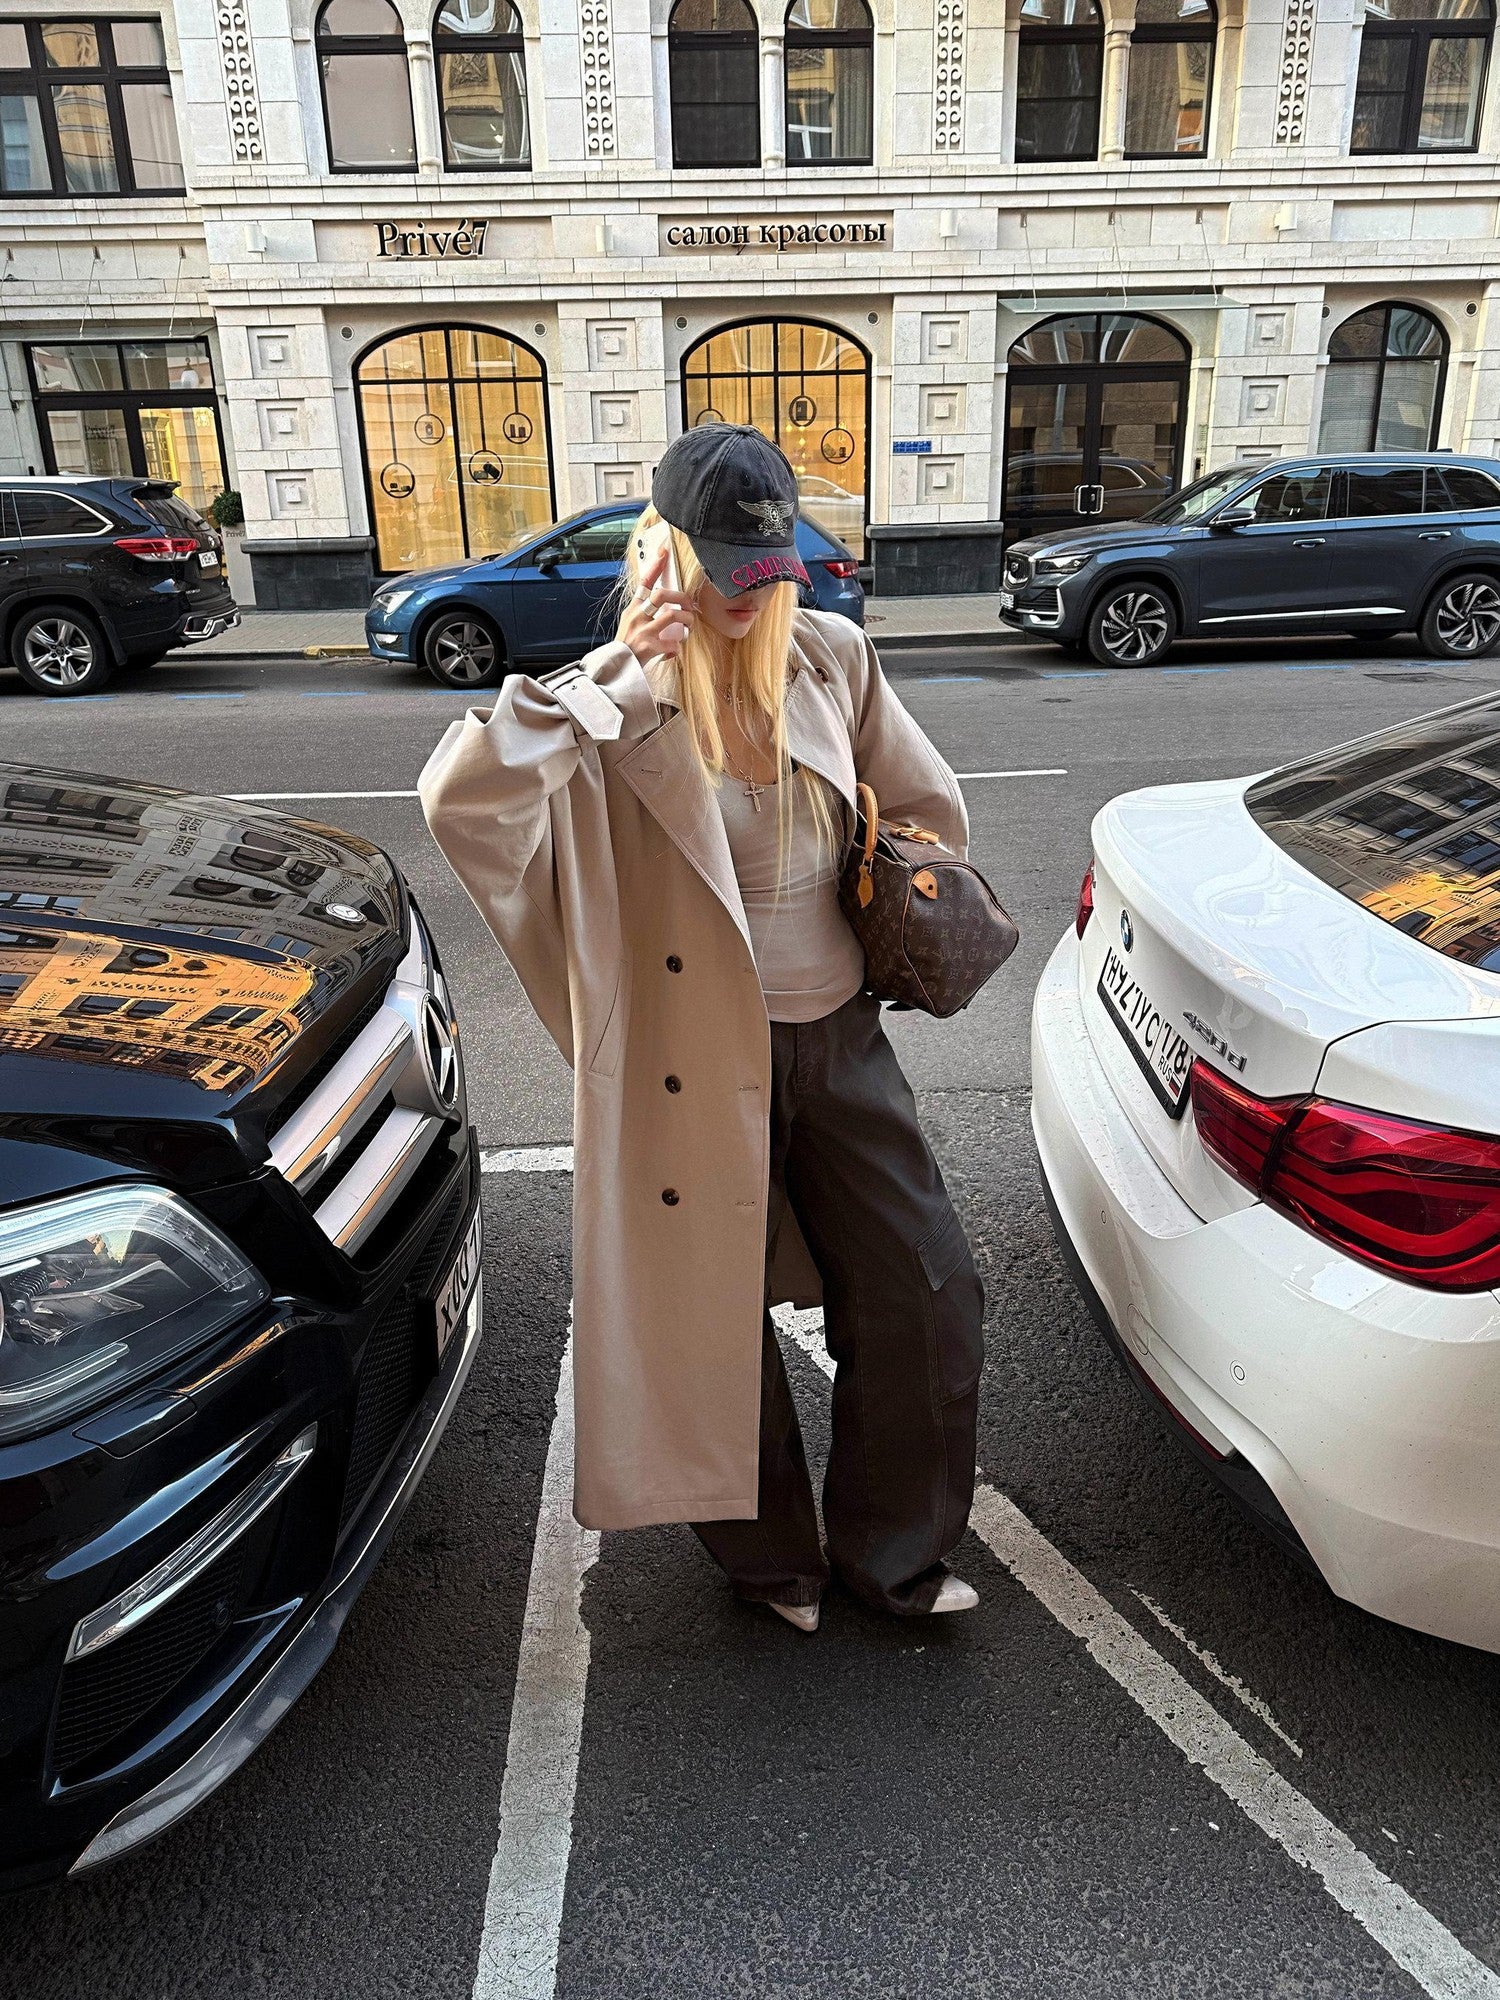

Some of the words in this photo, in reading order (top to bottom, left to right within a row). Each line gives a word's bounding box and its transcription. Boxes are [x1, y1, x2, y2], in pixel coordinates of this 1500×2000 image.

[374, 218, 488, 257] Privé7
[667, 226, 749, 246] салон
[759, 220, 887, 251] красоты
[1183, 1011, 1247, 1072] 420d
[1158, 1055, 1173, 1082] RUS
